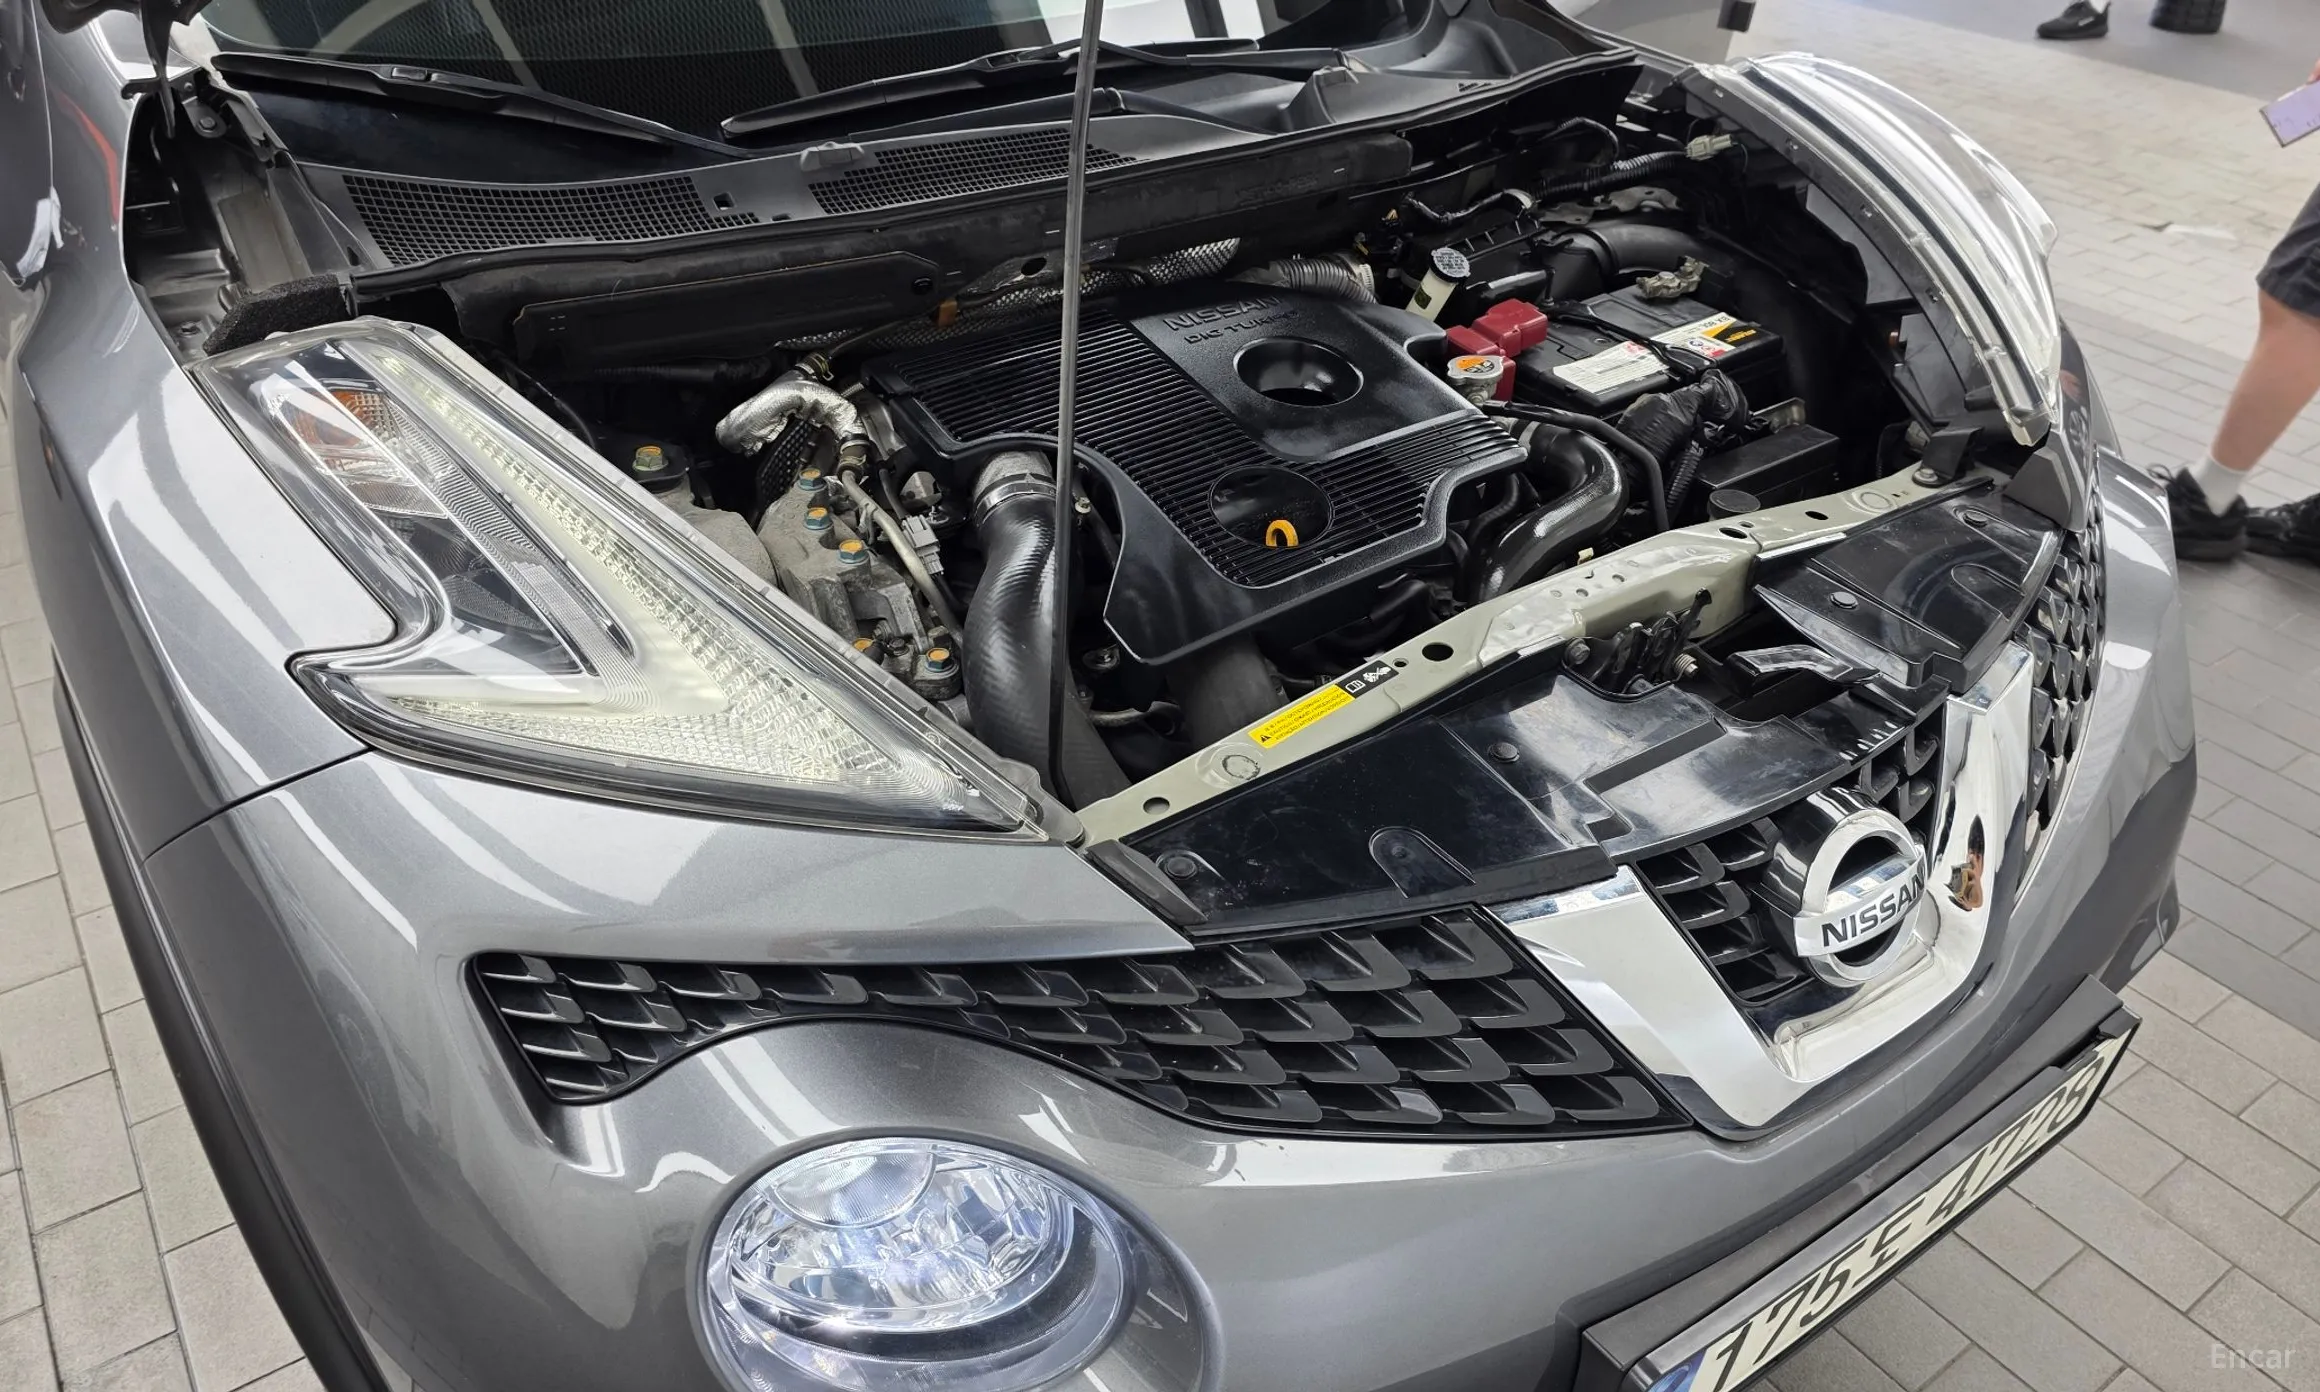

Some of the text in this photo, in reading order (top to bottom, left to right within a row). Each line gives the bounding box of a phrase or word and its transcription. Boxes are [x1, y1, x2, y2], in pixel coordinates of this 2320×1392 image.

[1163, 296, 1281, 331] NISSAN
[1821, 863, 1927, 948] NISSAN
[1713, 1056, 2105, 1392] 175도 4728
